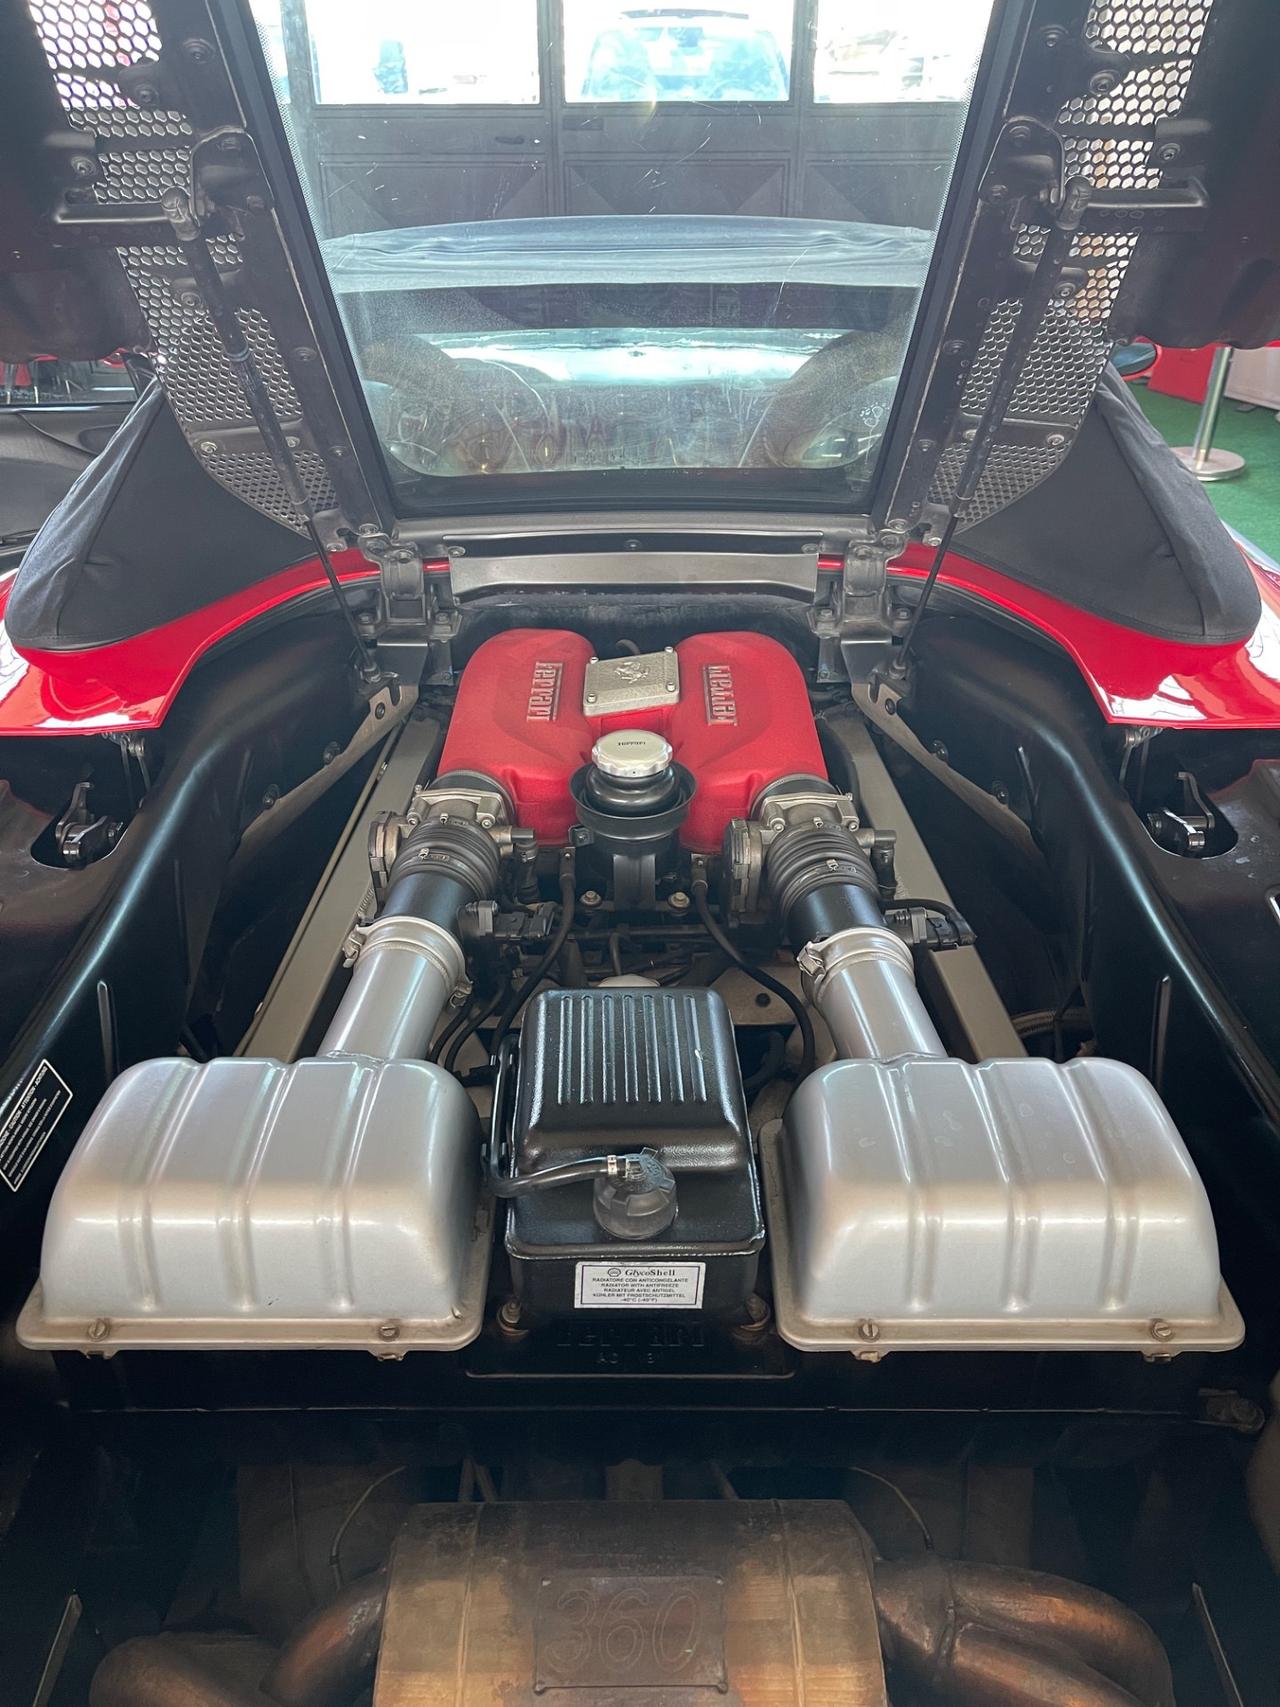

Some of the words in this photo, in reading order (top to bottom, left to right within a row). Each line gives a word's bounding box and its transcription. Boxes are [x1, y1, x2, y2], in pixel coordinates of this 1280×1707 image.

[526, 661, 564, 723] Ferrari
[702, 664, 738, 726] Ferrari
[625, 1269, 676, 1277] GlycoShell
[545, 1587, 698, 1675] 360
